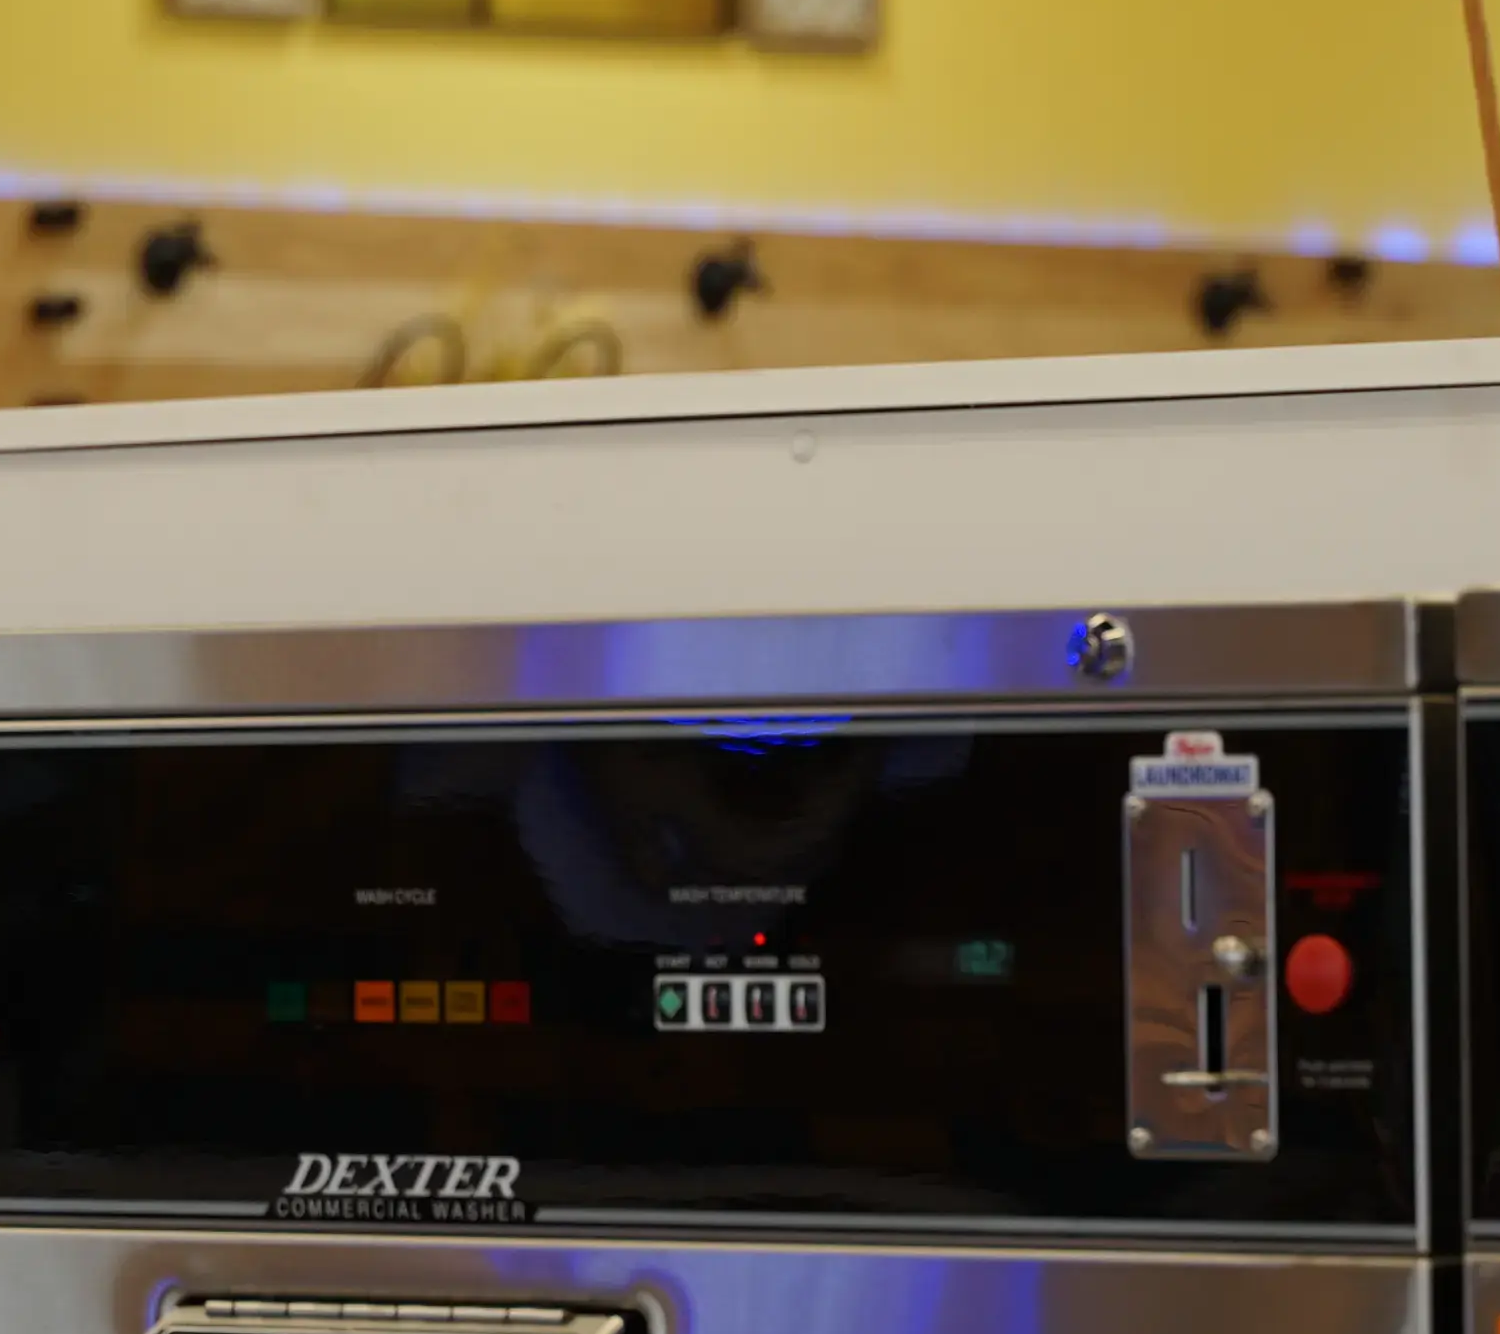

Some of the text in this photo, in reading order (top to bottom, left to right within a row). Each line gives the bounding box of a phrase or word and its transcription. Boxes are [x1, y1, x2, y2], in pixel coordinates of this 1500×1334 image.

[284, 1153, 520, 1199] DEXTER
[275, 1198, 526, 1222] COMMERCIAL WASHER
